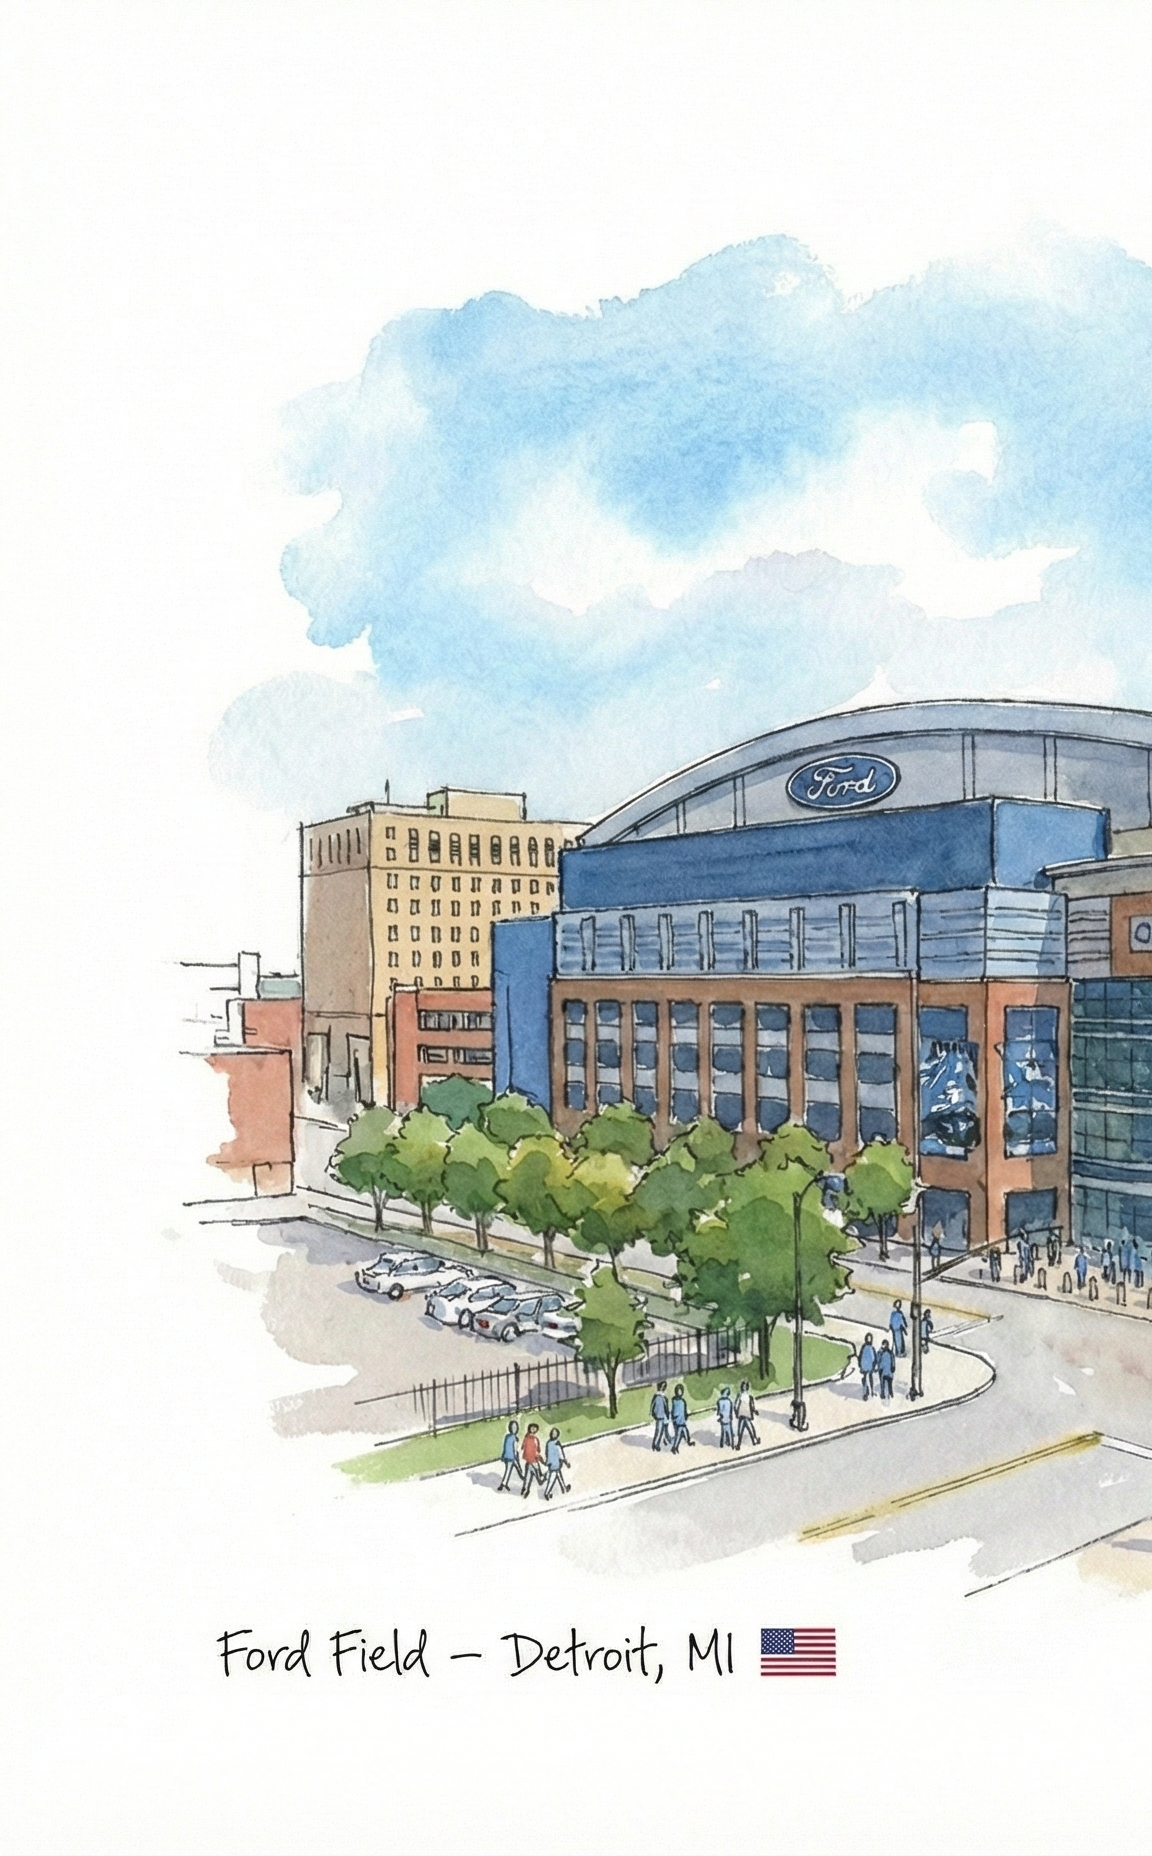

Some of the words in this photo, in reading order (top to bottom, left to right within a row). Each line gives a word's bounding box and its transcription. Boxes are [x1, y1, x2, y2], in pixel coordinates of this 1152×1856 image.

[807, 766, 876, 800] Ford
[217, 1629, 311, 1677] Ford
[330, 1628, 429, 1677] Field
[501, 1626, 664, 1684] Detroit,
[688, 1628, 733, 1677] MI
